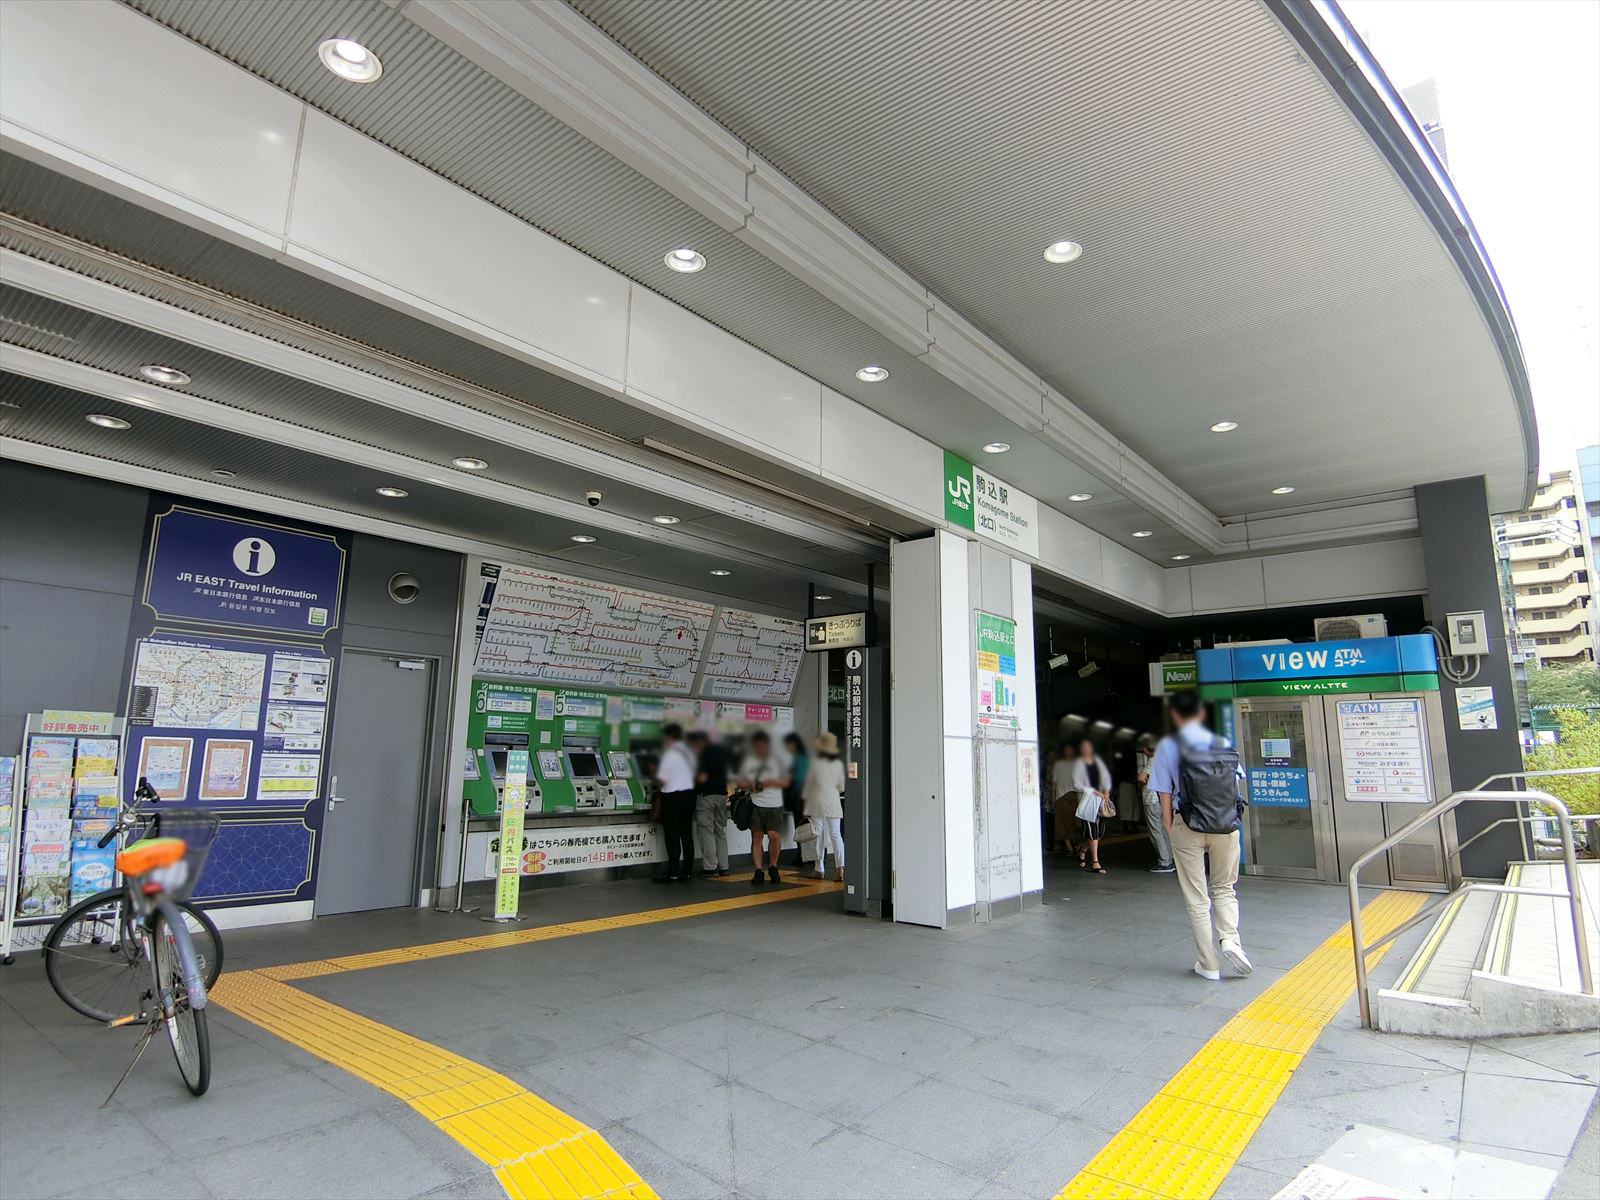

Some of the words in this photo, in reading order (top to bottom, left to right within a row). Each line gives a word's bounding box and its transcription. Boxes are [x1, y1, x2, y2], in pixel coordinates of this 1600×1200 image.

[948, 475, 971, 504] JR
[976, 474, 1008, 506] 駒込駅
[977, 496, 1008, 519] Komagome
[1010, 512, 1028, 528] Station
[978, 513, 996, 532] (北口)
[176, 572, 192, 582] JR
[195, 574, 226, 587] EAST
[228, 579, 260, 592] Travel
[262, 584, 318, 600] Information
[828, 617, 862, 630] きっぷうりば
[1334, 648, 1362, 659] ATM
[1334, 658, 1366, 667] コーナー
[1166, 671, 1194, 682] New
[478, 692, 486, 711] 6
[556, 695, 564, 713] 5
[1353, 704, 1378, 713] ATM
[852, 675, 861, 748] 駒込駅総合案内
[491, 833, 646, 852] 定はこちらの券売機でも購入できます!
